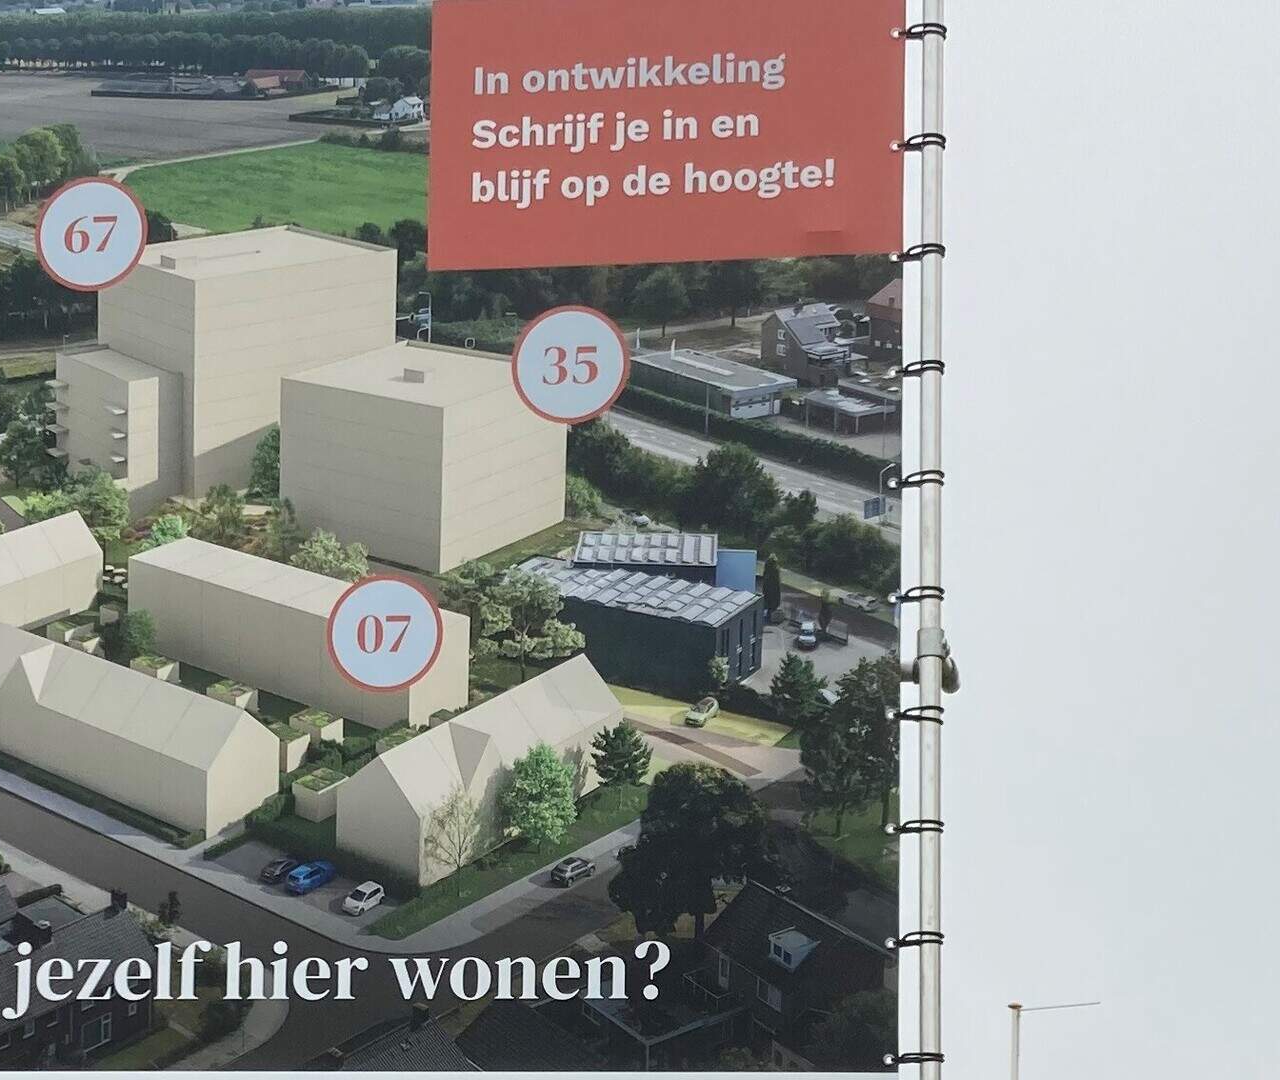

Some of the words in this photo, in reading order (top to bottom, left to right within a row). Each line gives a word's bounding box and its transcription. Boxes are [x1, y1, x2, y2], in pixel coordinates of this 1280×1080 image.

[475, 67, 508, 94] In
[522, 53, 785, 92] ontwikkeling
[472, 113, 605, 152] Schrijf
[610, 112, 649, 151] je
[663, 109, 697, 139] in
[712, 114, 758, 137] en
[472, 169, 550, 208] blijf
[561, 175, 609, 206] op
[623, 165, 670, 196] de
[685, 159, 834, 198] hoogte!
[64, 216, 117, 253] 67
[543, 346, 598, 385] 35
[357, 615, 411, 653] 07
[3, 941, 211, 1019] jezelf
[224, 941, 368, 1000] hier
[394, 941, 669, 1000] wonen?
